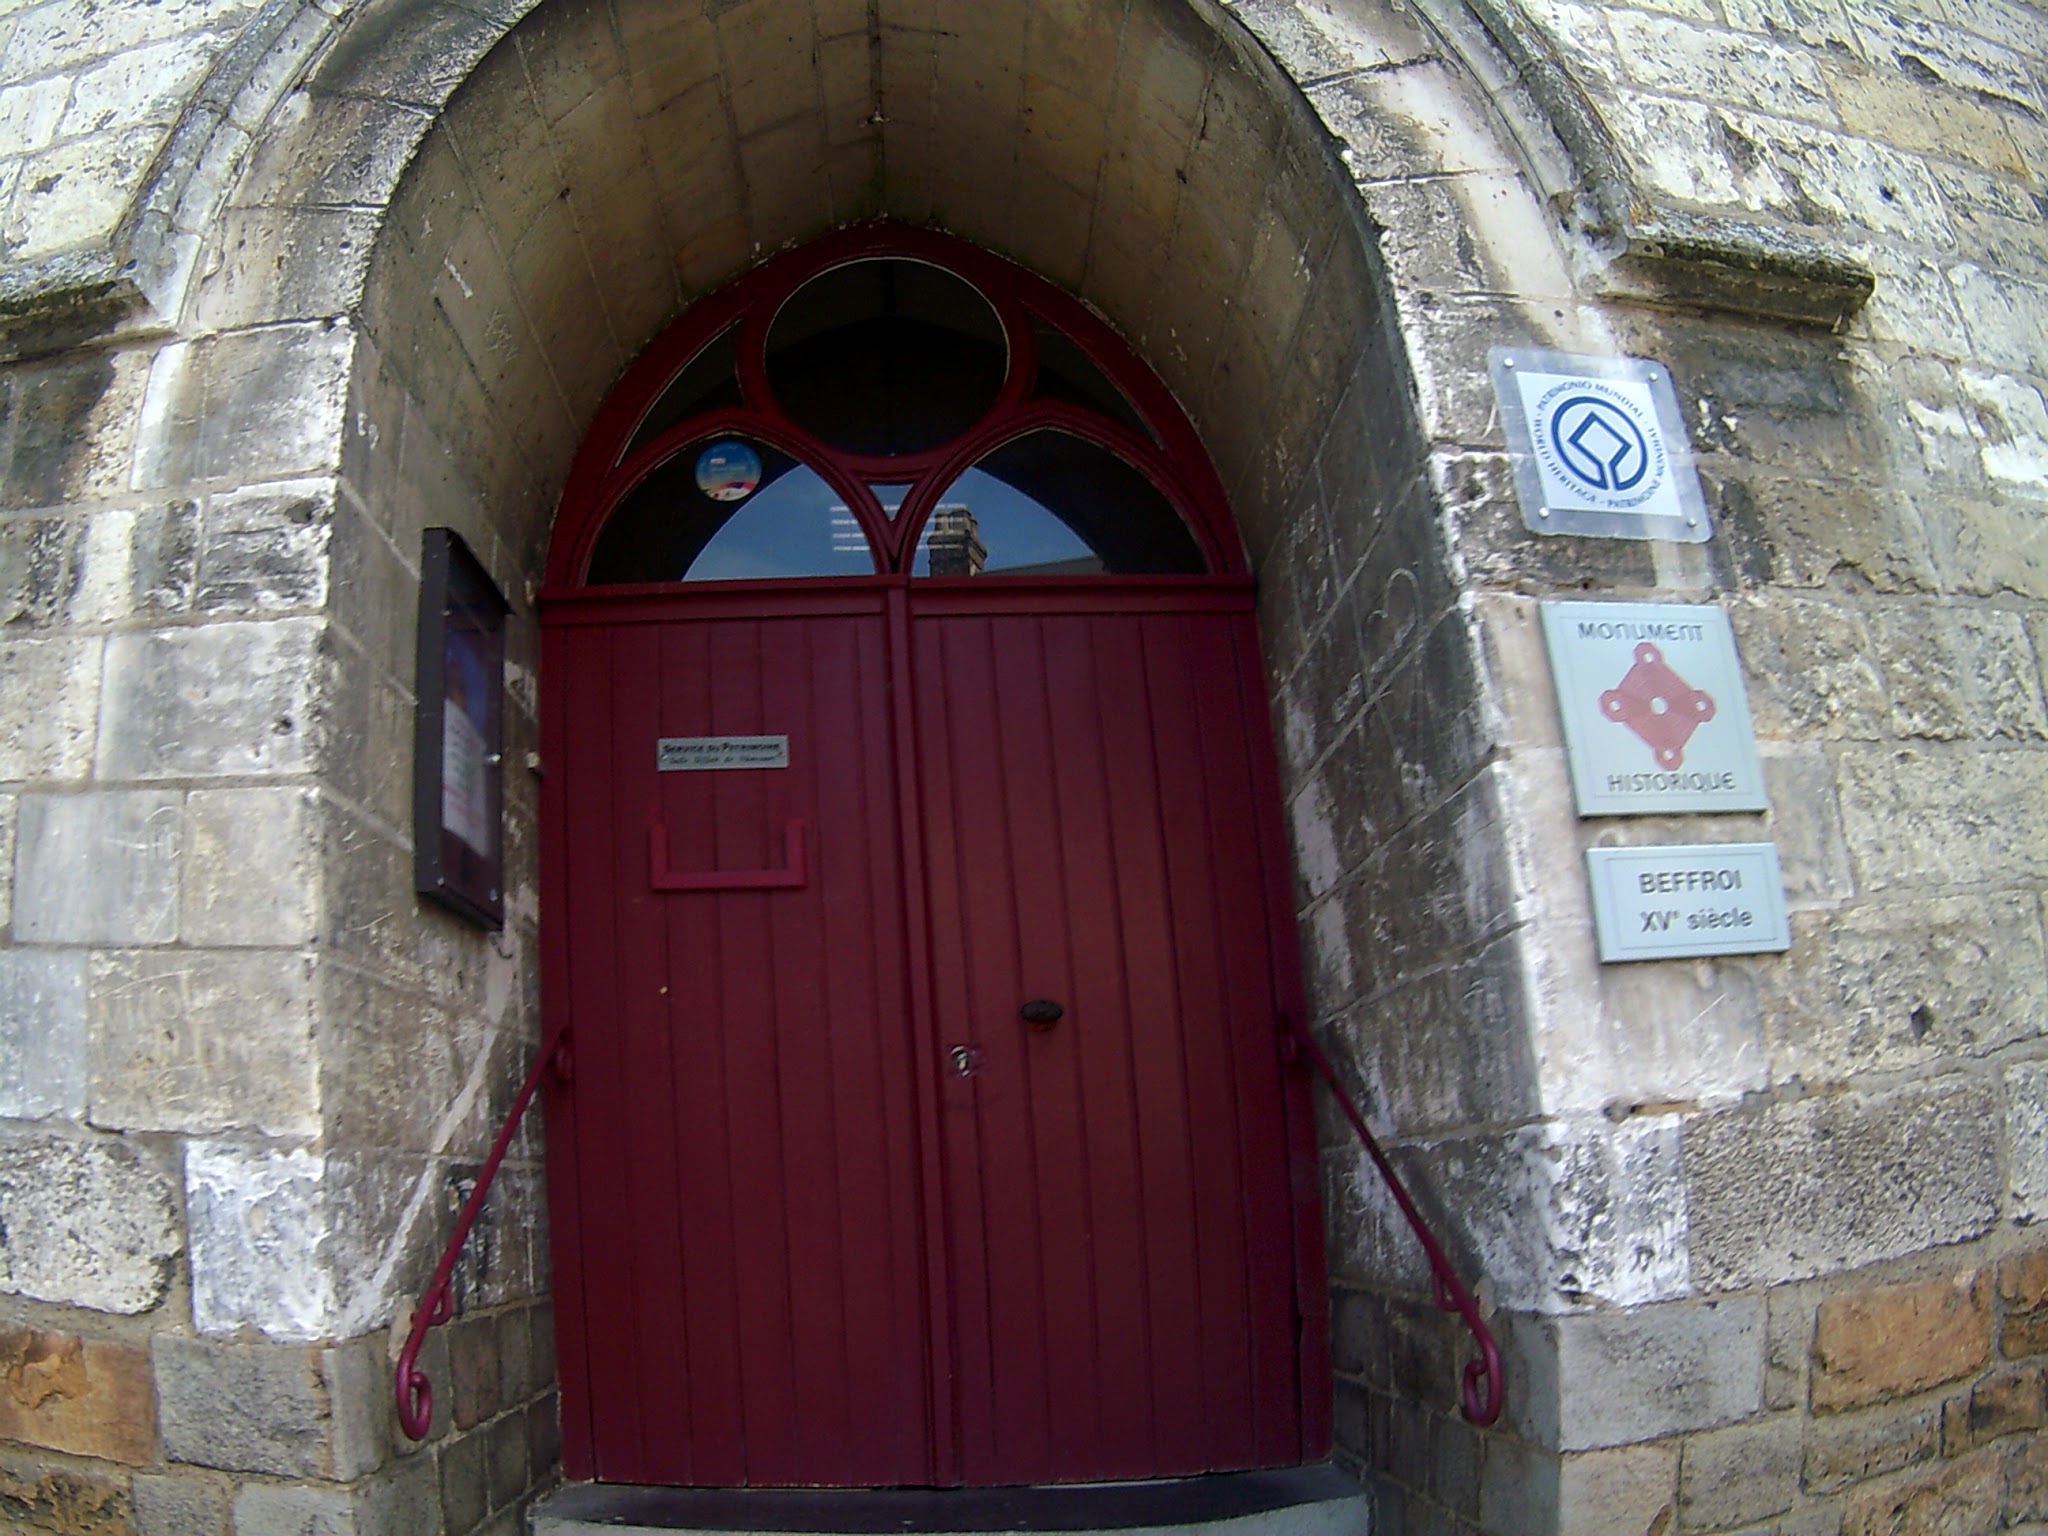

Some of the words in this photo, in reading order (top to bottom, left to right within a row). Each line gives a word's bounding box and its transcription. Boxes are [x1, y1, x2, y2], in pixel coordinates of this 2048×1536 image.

[1578, 622, 1704, 641] MONUMENT
[1607, 772, 1736, 793] HISTORIQUE
[1638, 868, 1742, 894] BEFFROI
[1686, 907, 1753, 930] siècle
